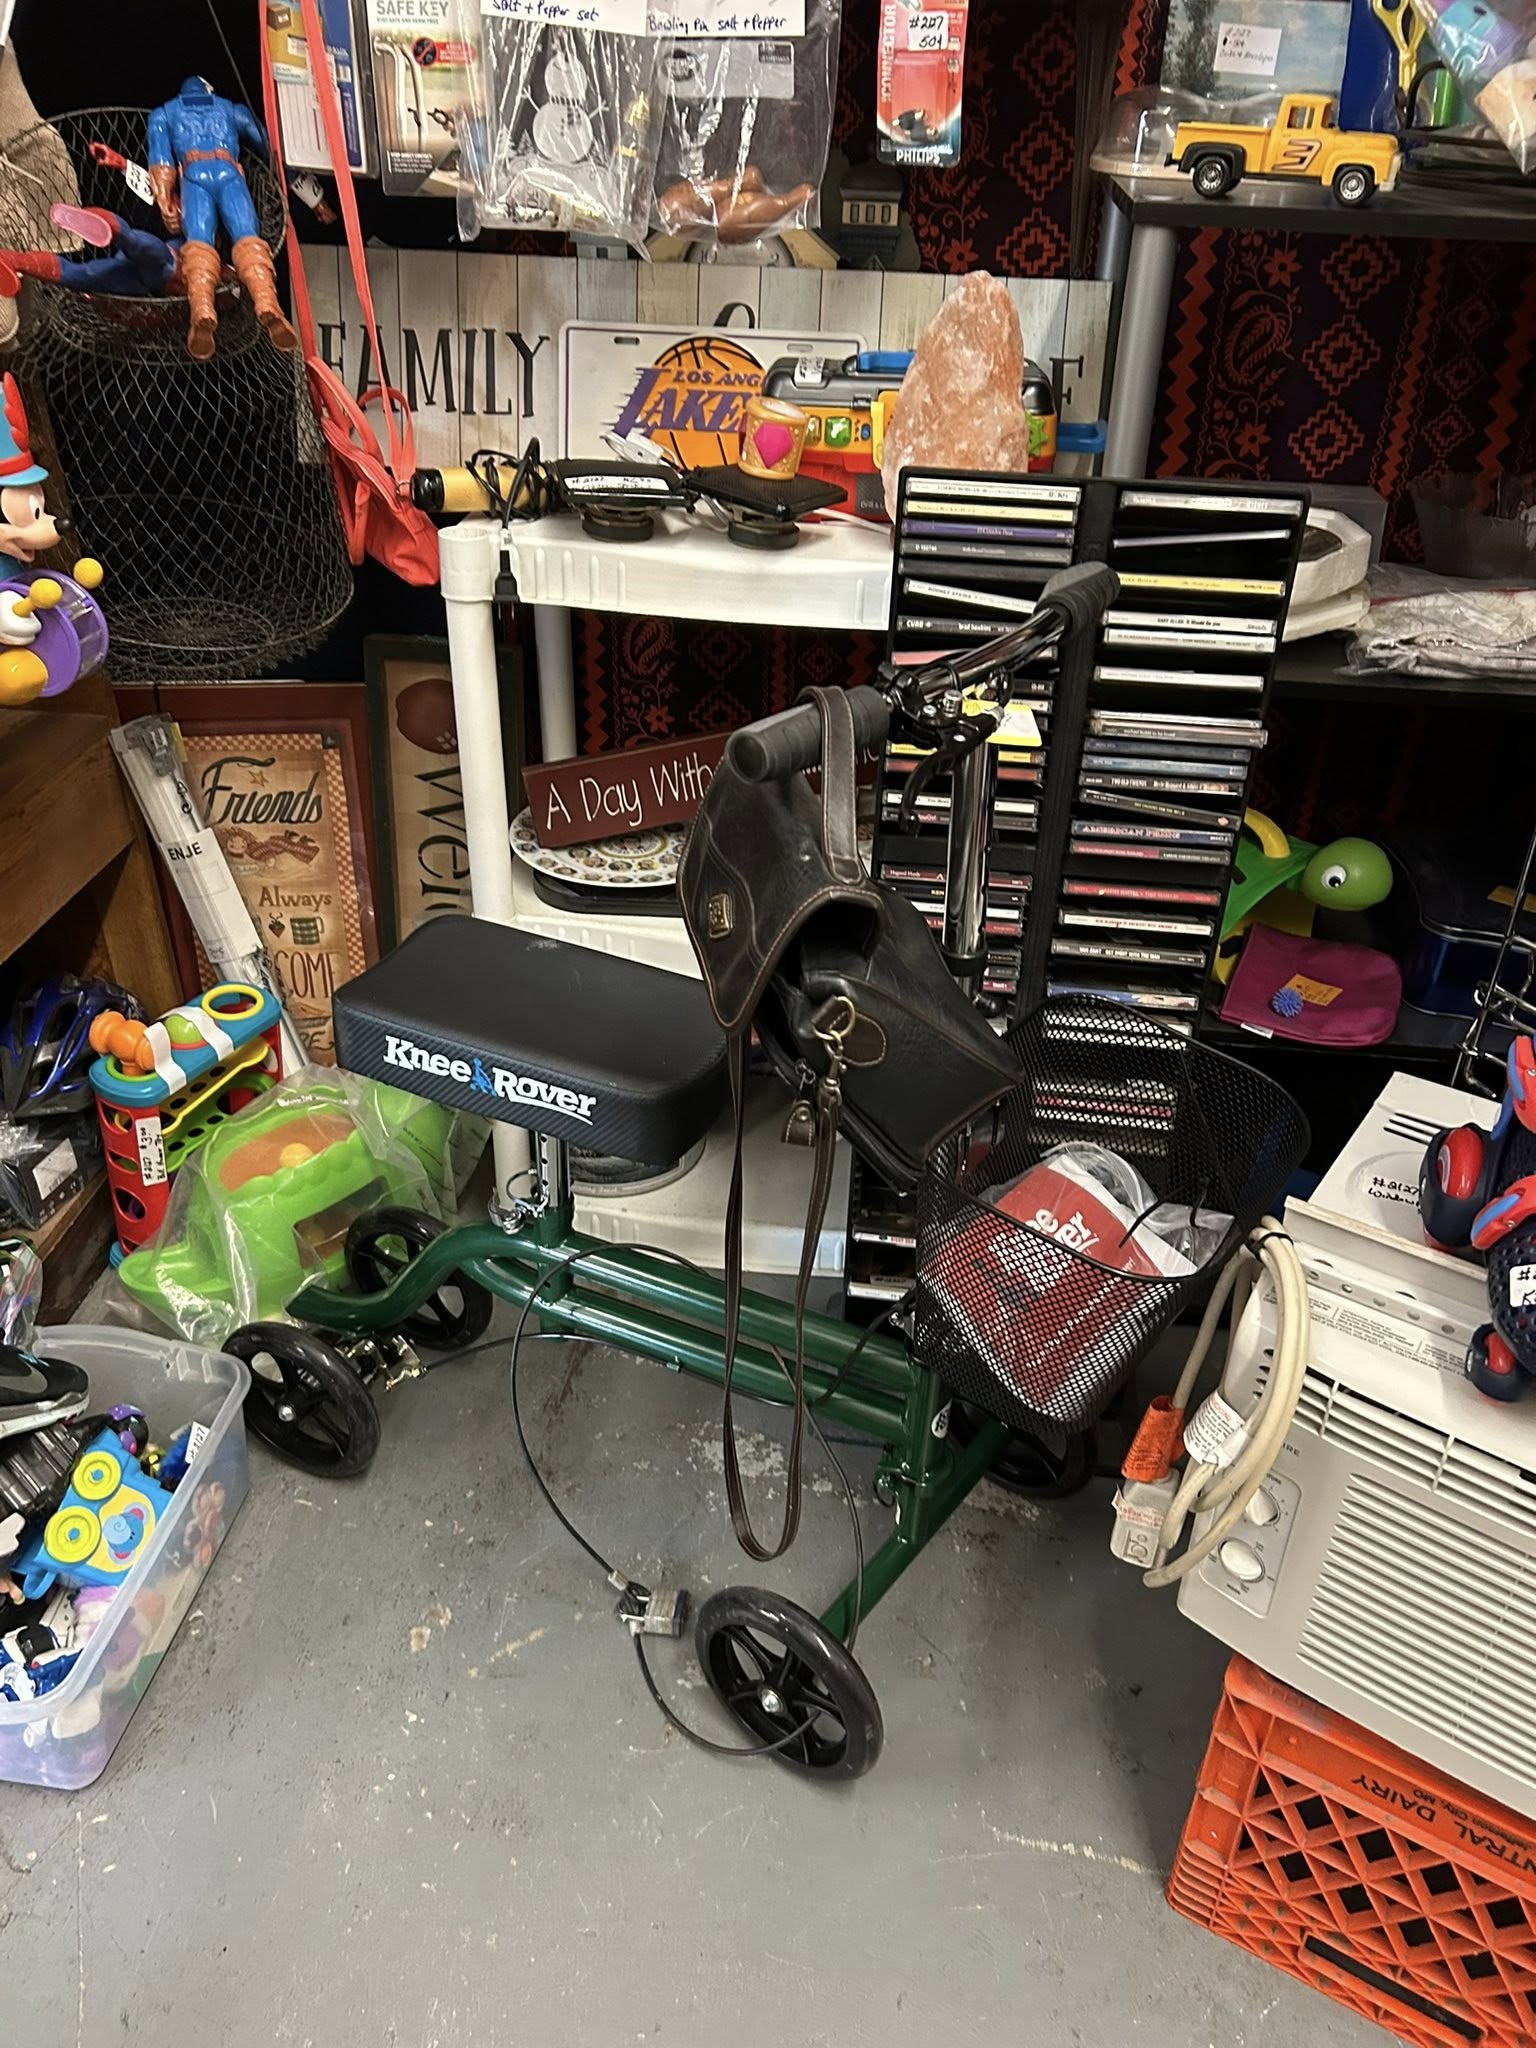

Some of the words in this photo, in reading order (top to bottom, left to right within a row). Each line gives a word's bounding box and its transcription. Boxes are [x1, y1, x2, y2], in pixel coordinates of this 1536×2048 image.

[376, 0, 414, 15] SAFE
[420, 1, 448, 16] KEY
[896, 147, 940, 164] PHILIPS
[318, 323, 550, 418] FAMILY
[673, 370, 713, 384] LOS
[613, 367, 760, 438] LAKE
[202, 756, 324, 826] Friends
[546, 784, 572, 830] A
[579, 777, 642, 826] Day
[167, 842, 204, 861] ENJE
[259, 886, 332, 912] Always
[383, 1035, 472, 1082] Knee
[492, 1067, 597, 1119] Rover
[1350, 1772, 1437, 1824] DAIRY
